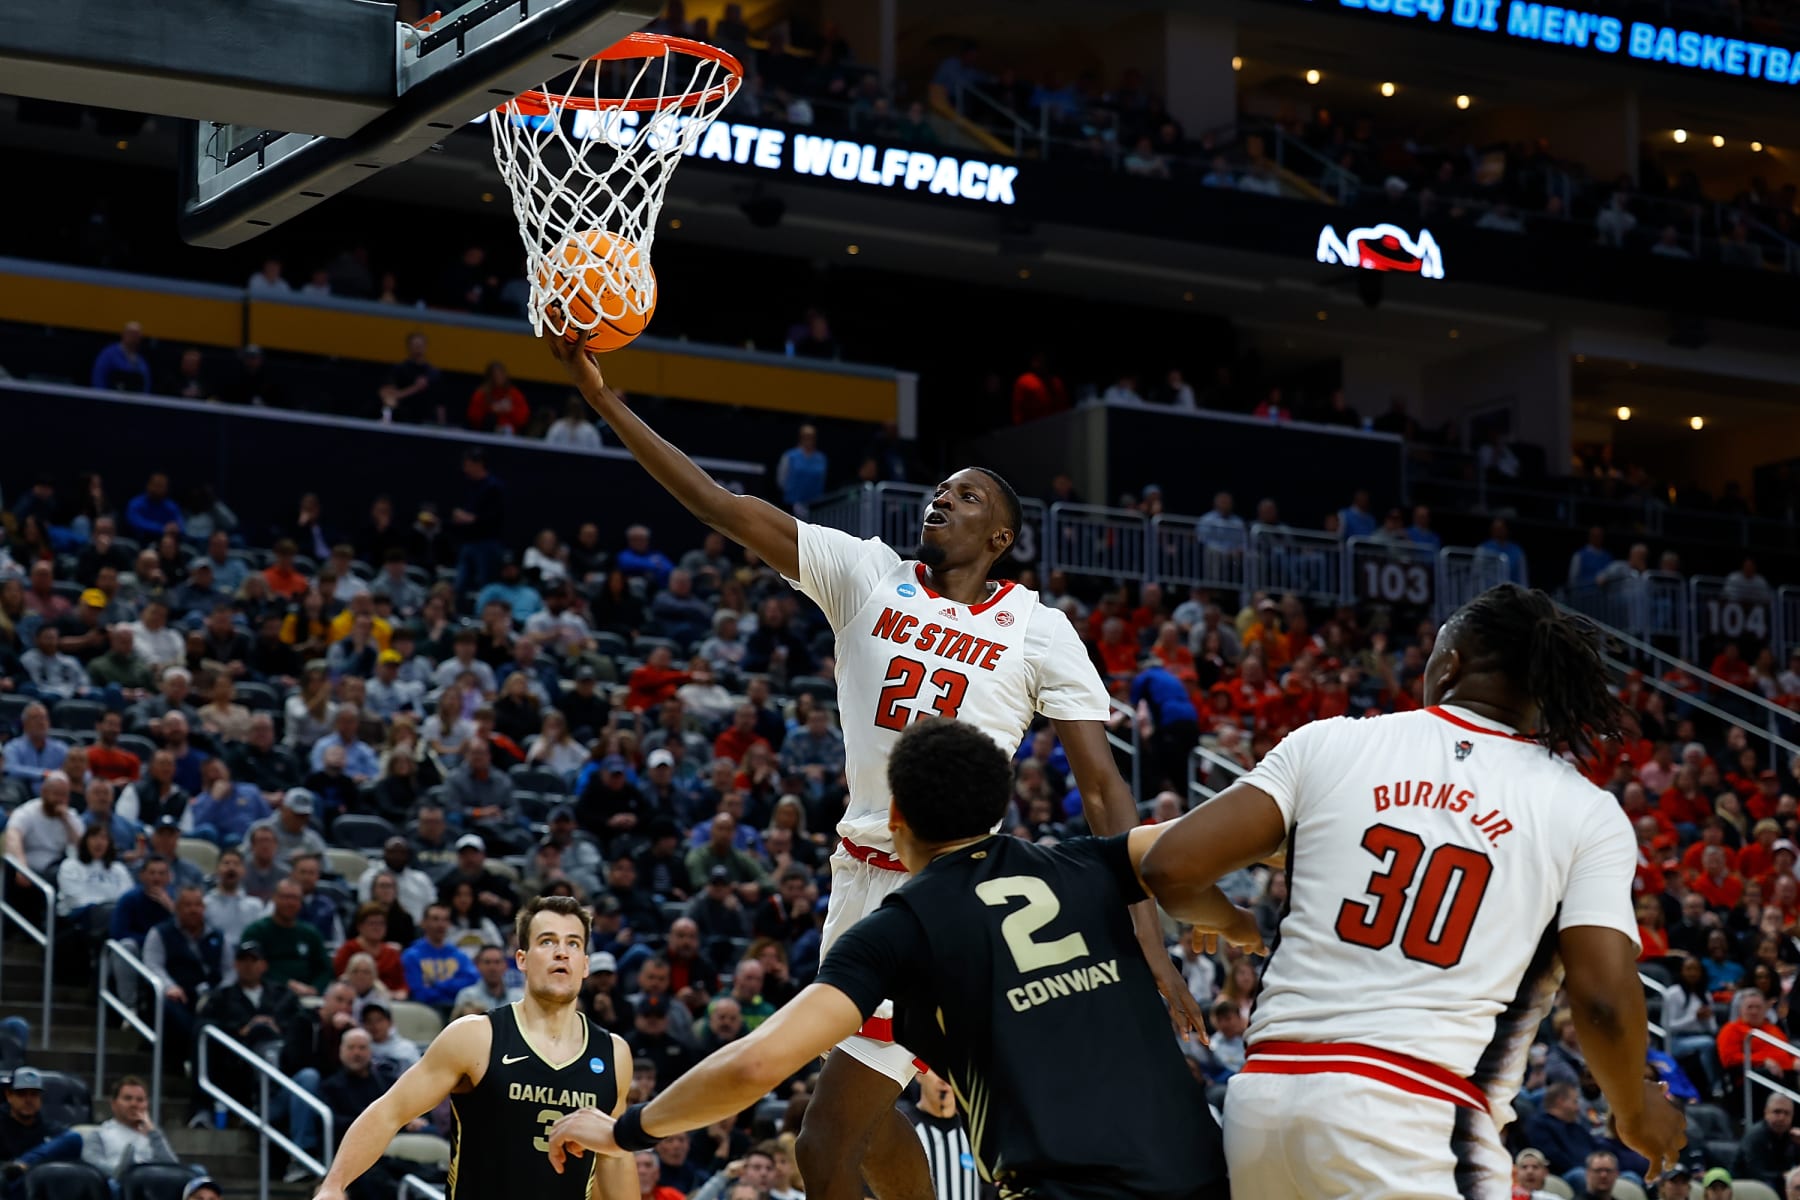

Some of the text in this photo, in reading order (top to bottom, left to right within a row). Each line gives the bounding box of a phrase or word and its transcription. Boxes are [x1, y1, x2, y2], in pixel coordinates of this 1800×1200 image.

[1339, 0, 1445, 22] 24
[1451, 0, 1499, 32] DI
[1507, 0, 1623, 53] MEN'S
[572, 109, 640, 146] NC
[647, 112, 785, 169] STATE
[793, 133, 1019, 205] WOLFPACK
[1363, 562, 1429, 604] 103
[871, 607, 1009, 671] NC STATE
[938, 610, 959, 622] adidas
[1707, 600, 1767, 639] 104
[874, 655, 969, 733] 23
[1373, 780, 1514, 849] BURNS JR.
[975, 875, 1090, 974] 2
[1334, 822, 1494, 970] 30
[1006, 959, 1121, 1013] CONWAY
[508, 1082, 598, 1110] OAKLAND
